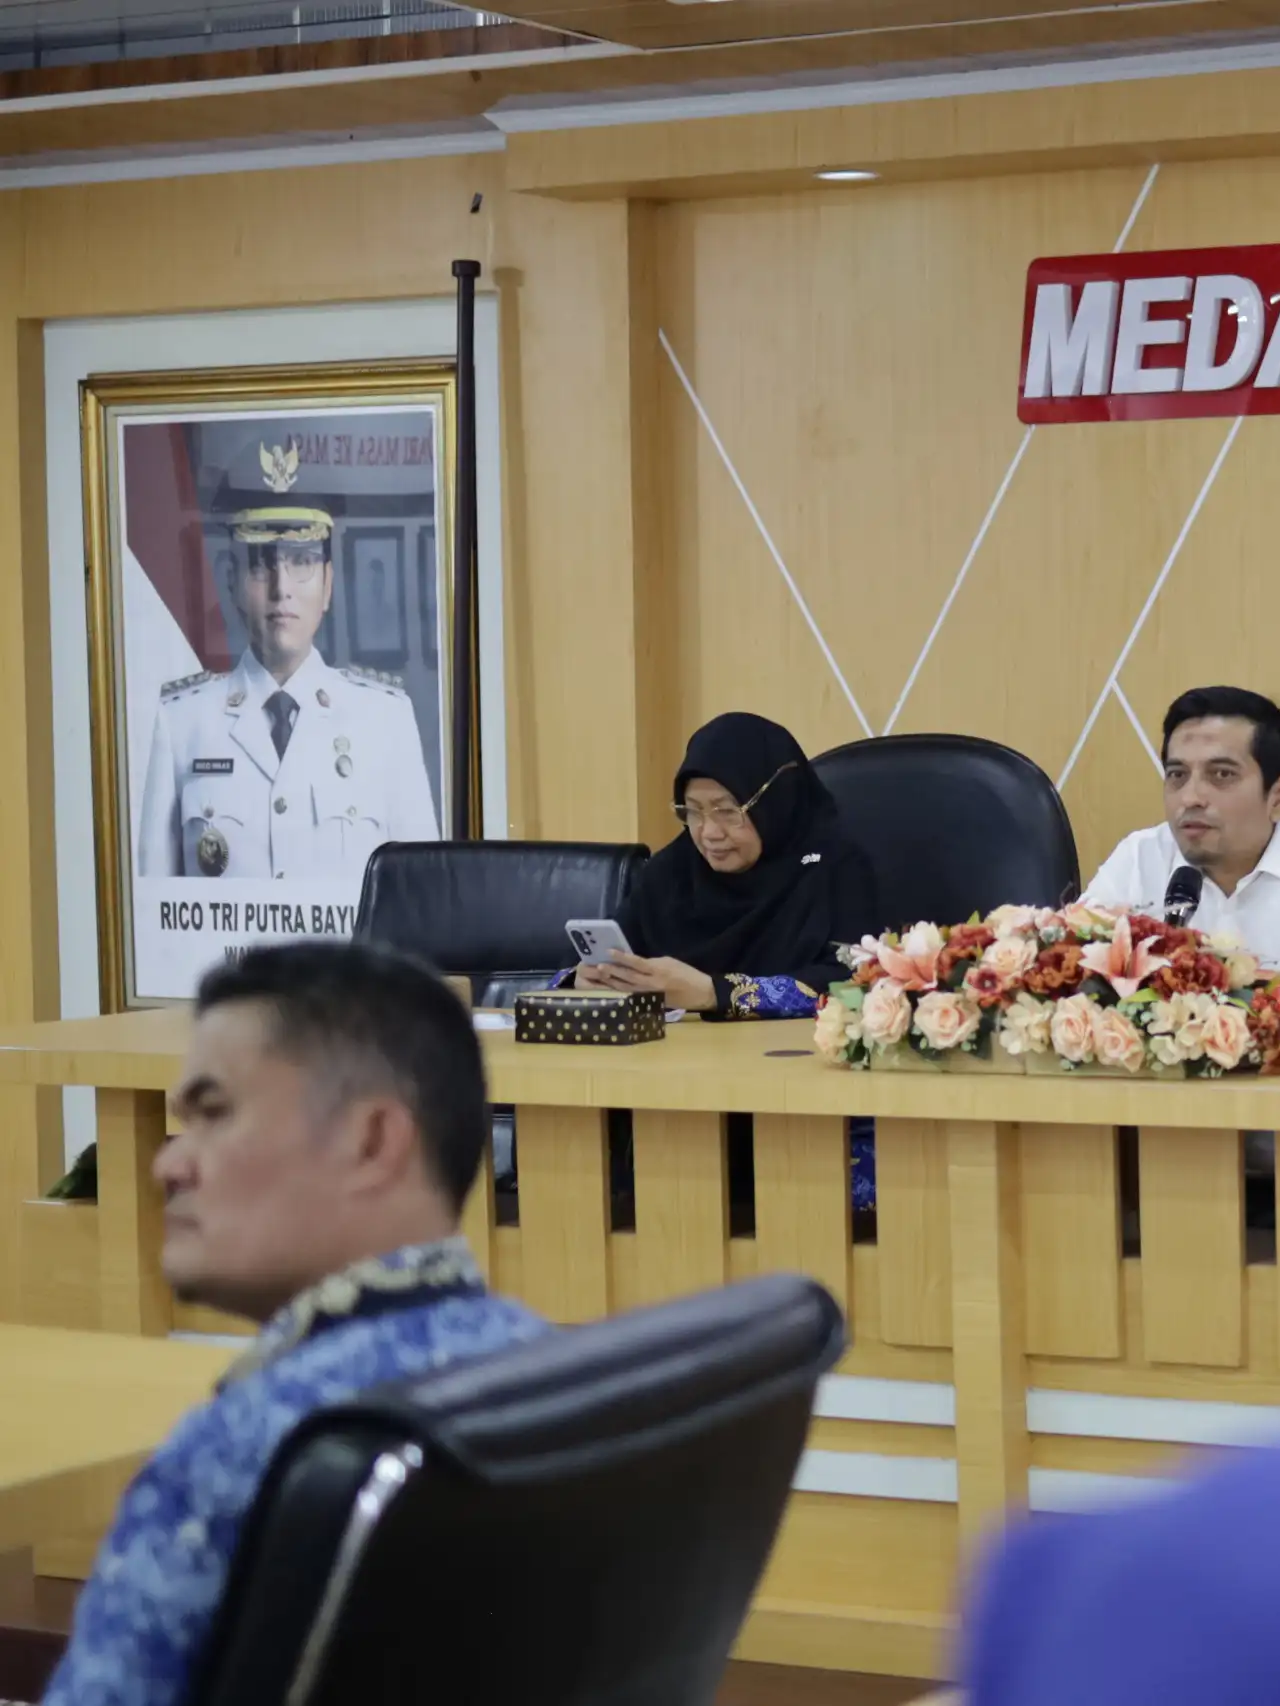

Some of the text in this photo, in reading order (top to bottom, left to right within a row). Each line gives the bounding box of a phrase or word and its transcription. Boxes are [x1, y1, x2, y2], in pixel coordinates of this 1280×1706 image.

[160, 901, 204, 931] RICO
[209, 903, 239, 931] TRI
[245, 903, 306, 933] PUTRA
